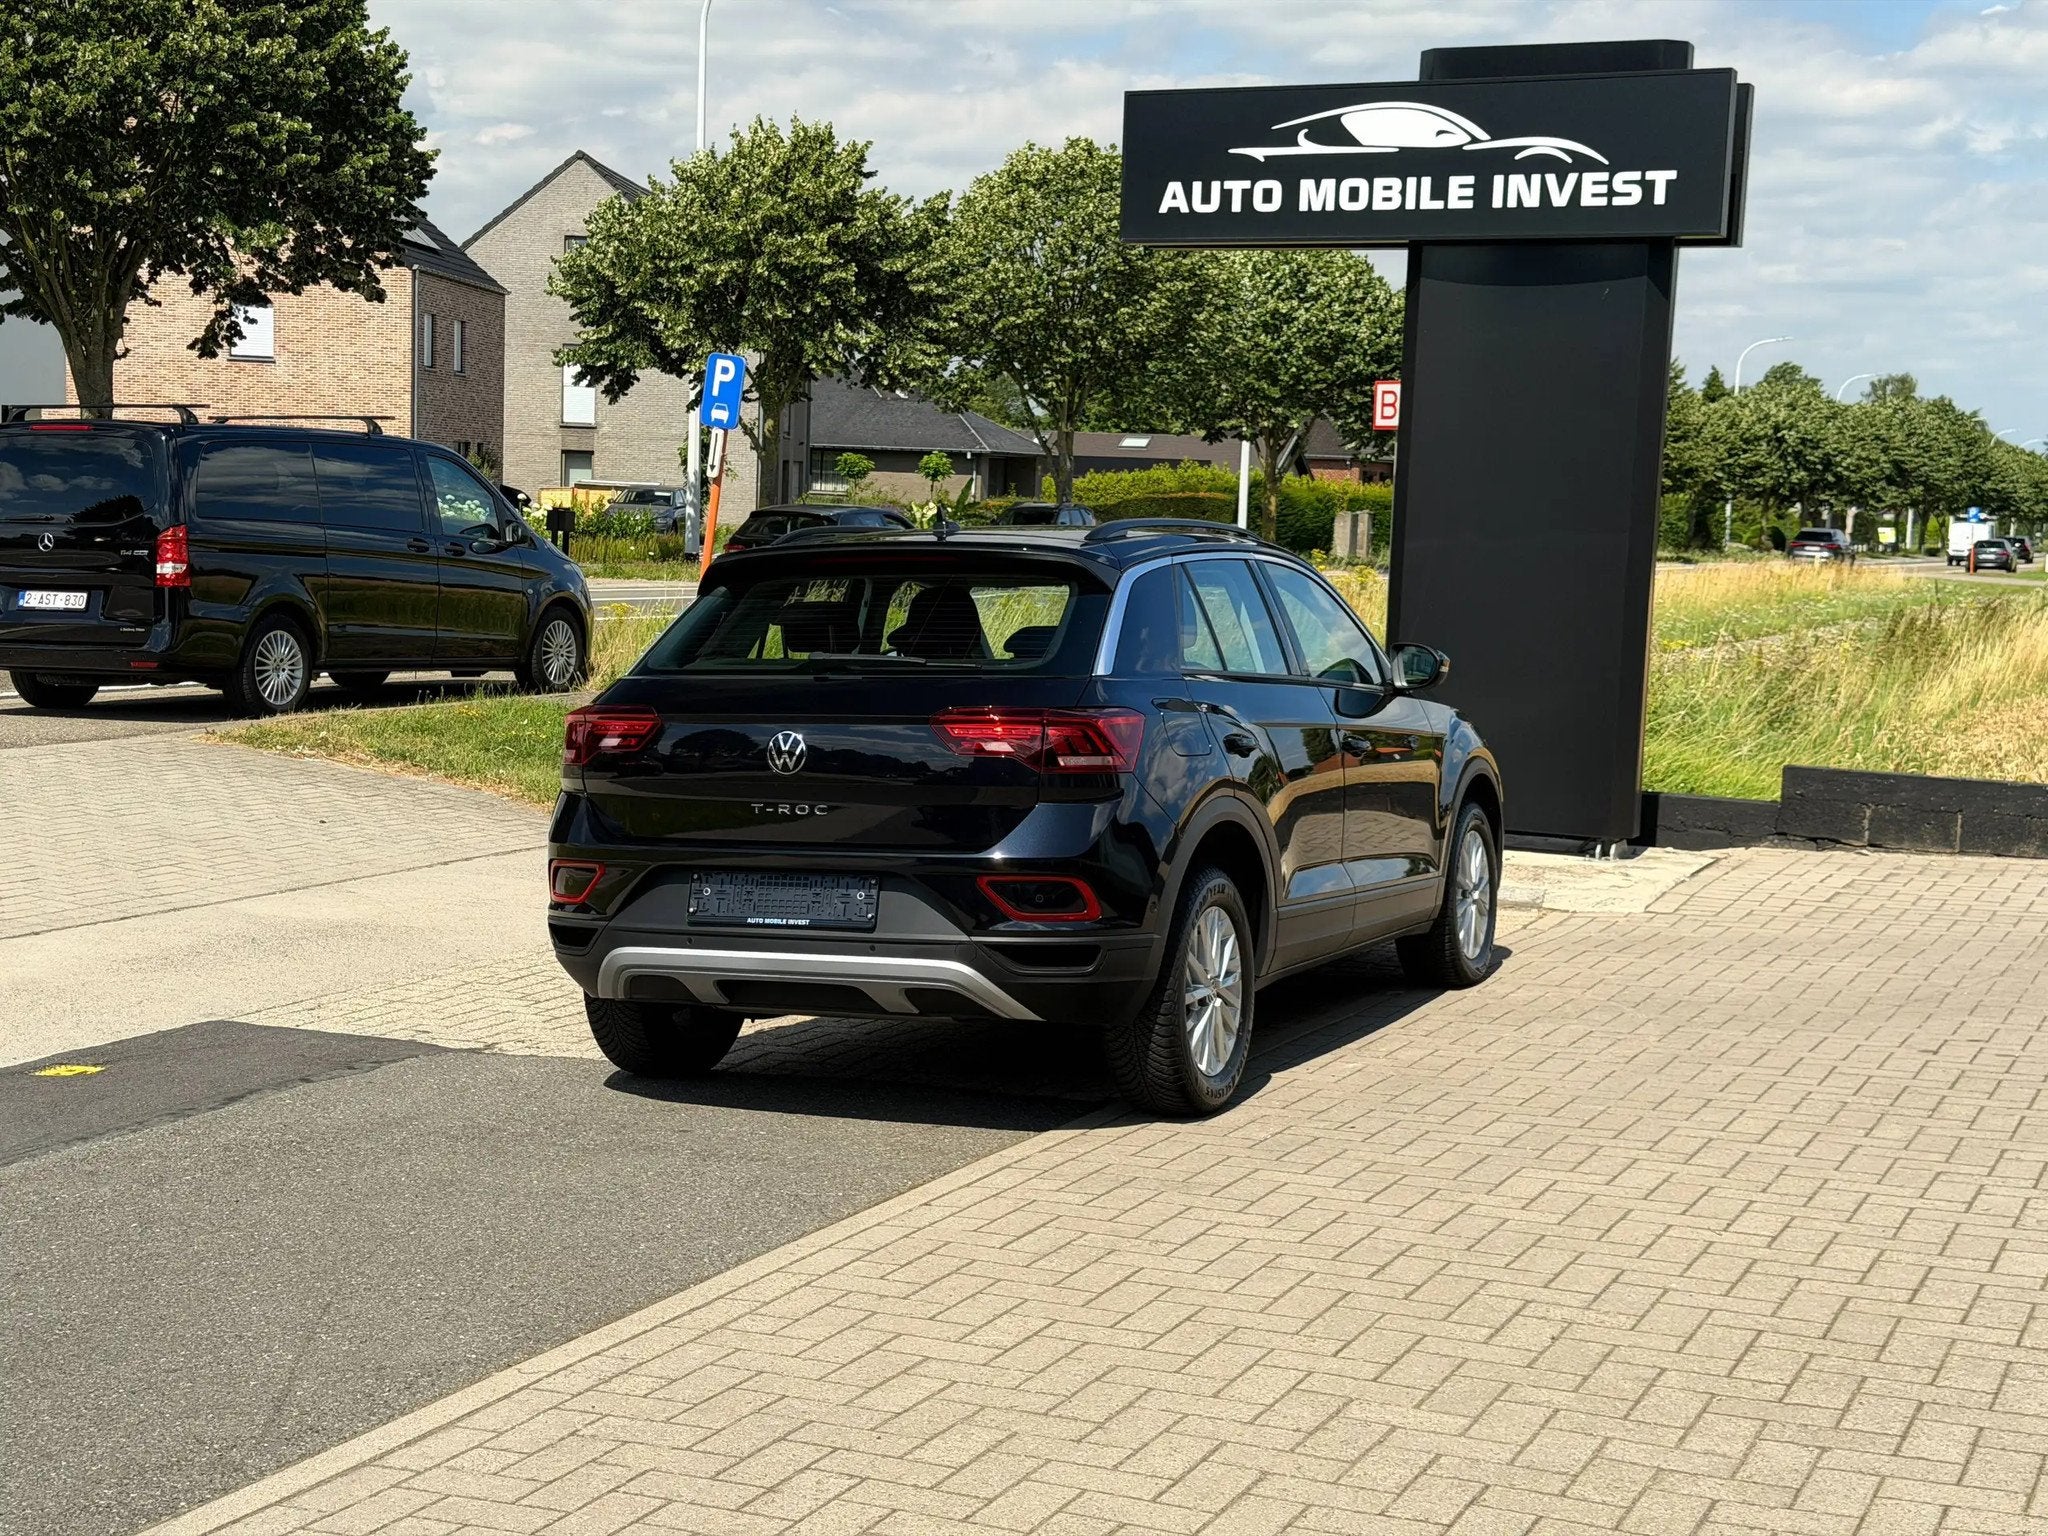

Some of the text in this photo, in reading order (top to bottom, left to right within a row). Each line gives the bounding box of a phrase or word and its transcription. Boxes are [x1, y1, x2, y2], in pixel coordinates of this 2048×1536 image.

[1158, 169, 1678, 214] AUTO MOBILE INVEST
[711, 358, 736, 397] P
[1380, 390, 1398, 420] B
[25, 592, 85, 606] 2-AST-830
[750, 803, 829, 816] T-ROC
